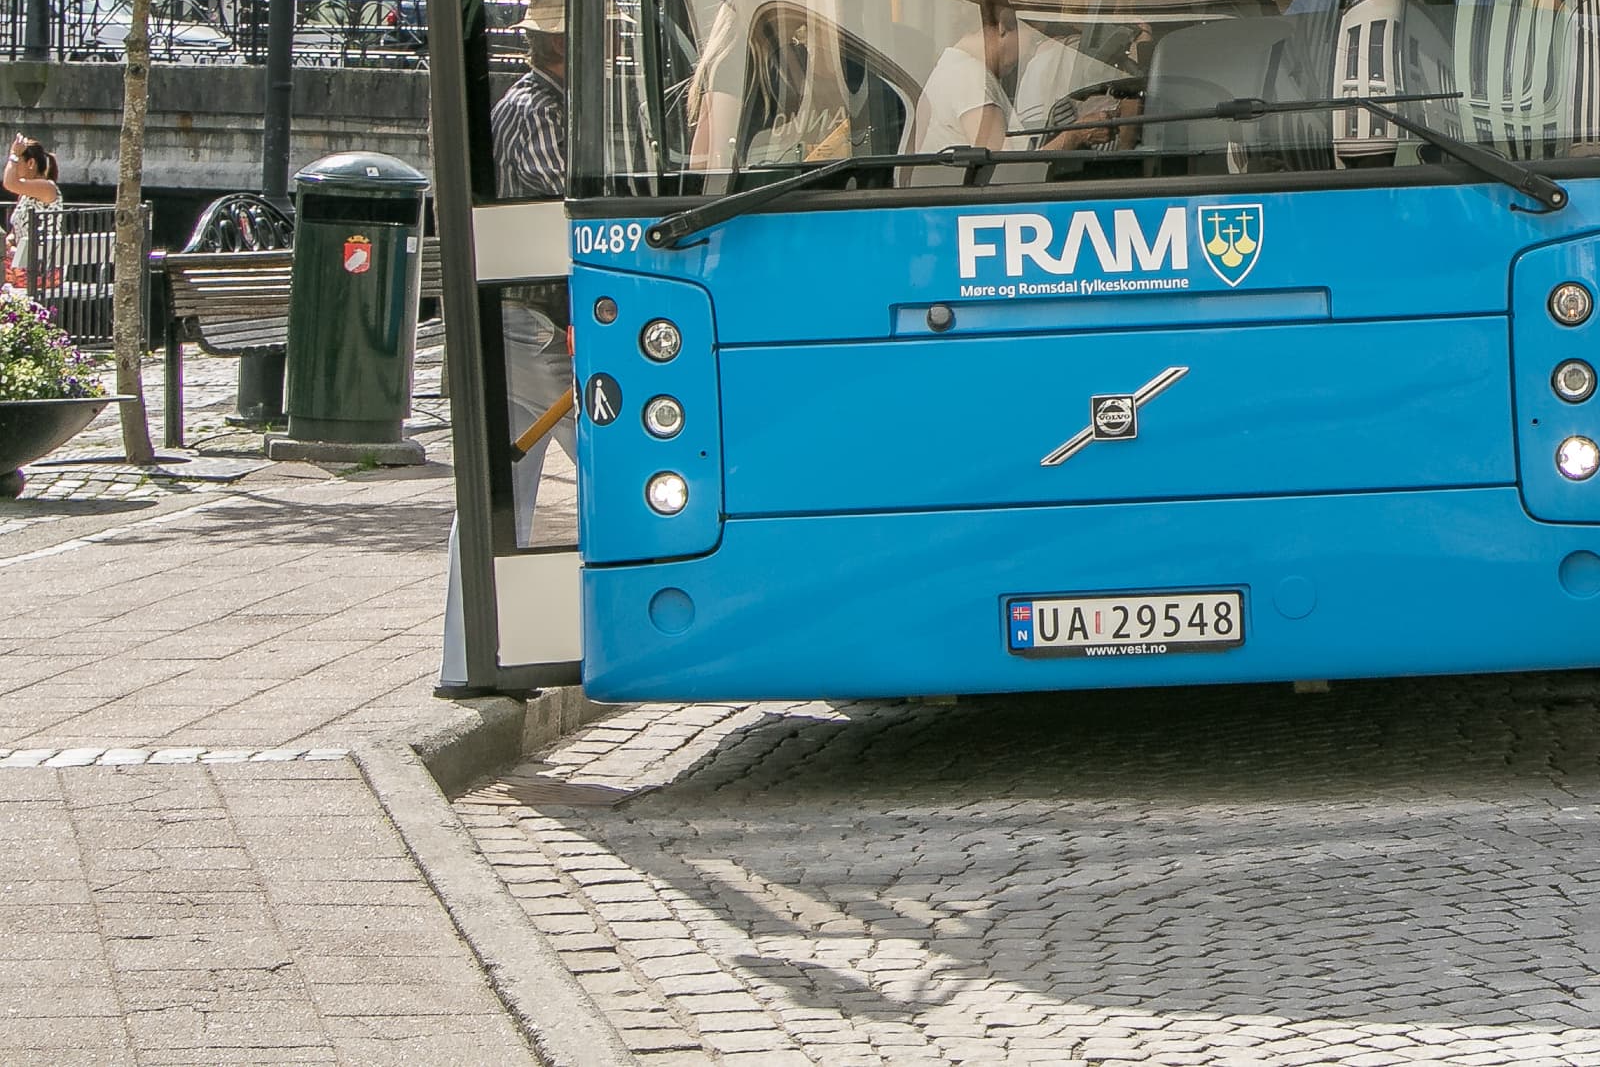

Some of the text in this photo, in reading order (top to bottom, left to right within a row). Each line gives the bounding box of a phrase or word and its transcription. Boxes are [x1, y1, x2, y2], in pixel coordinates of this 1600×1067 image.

[574, 223, 642, 254] 10489
[958, 206, 1188, 278] FRAM
[960, 277, 1189, 298] Møre og Romsdal fylkeskommune
[1098, 413, 1131, 421] VOLVO
[1038, 600, 1234, 642] UA 29548
[1085, 643, 1167, 657] www.vest.no
